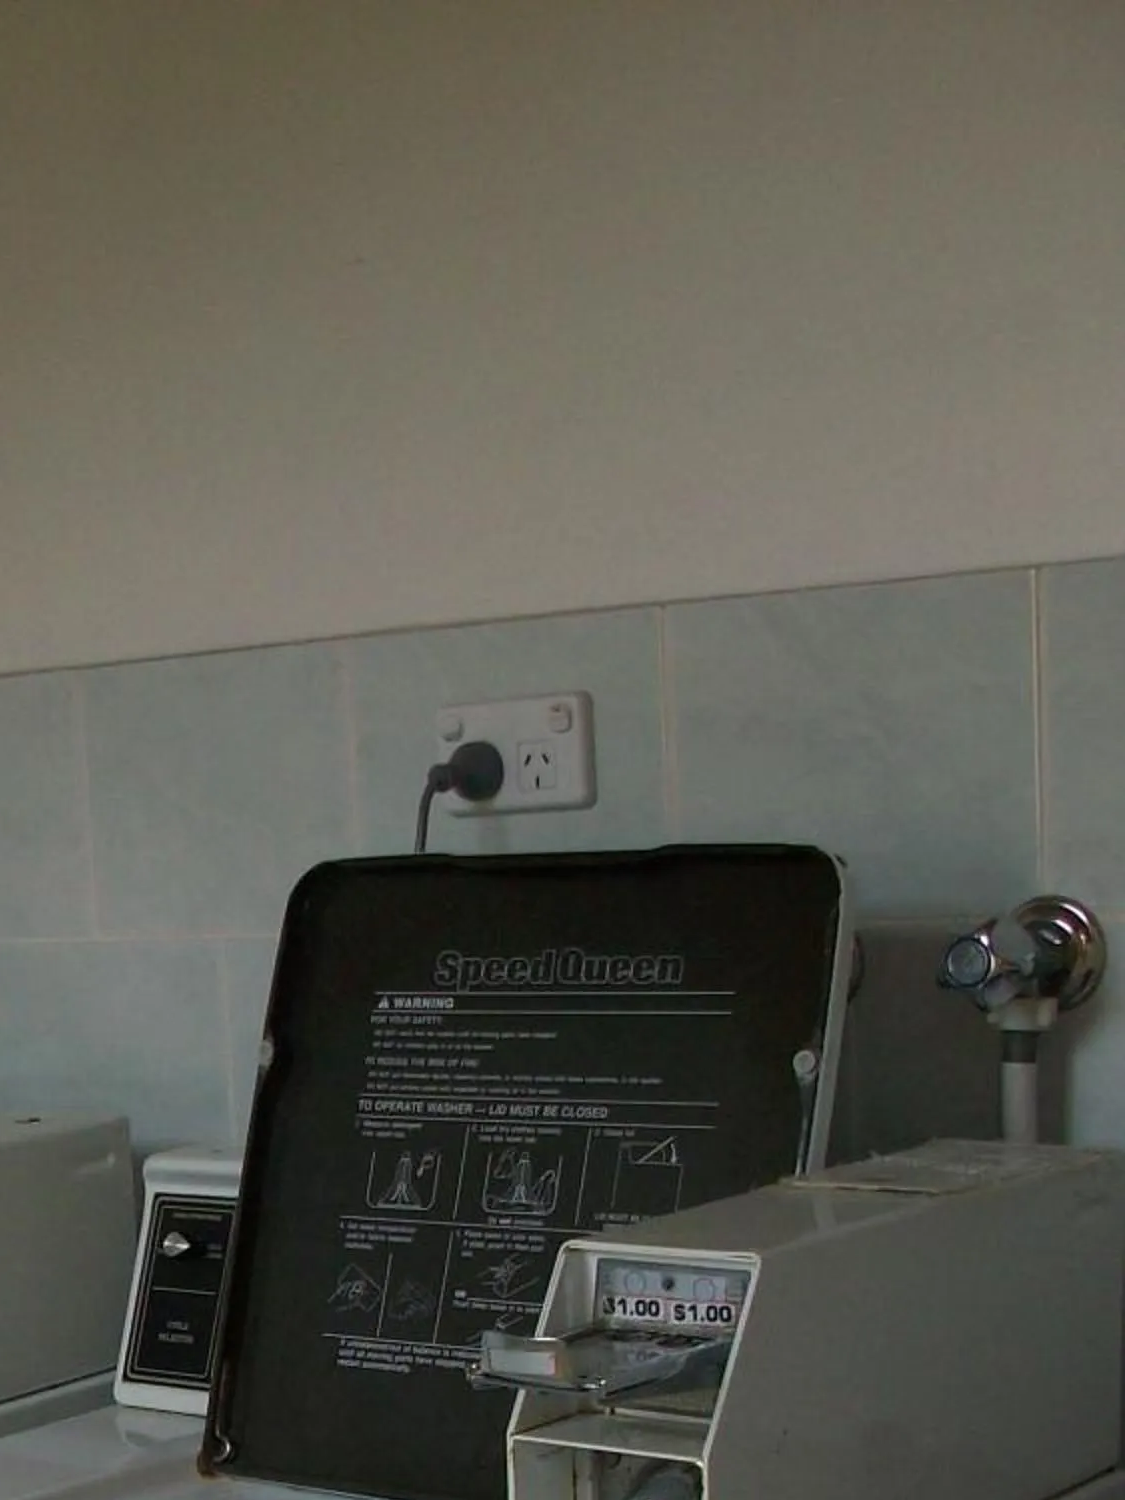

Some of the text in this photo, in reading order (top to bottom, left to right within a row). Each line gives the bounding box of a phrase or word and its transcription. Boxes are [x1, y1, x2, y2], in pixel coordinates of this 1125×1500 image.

[433, 948, 684, 991] Speed Queen
[394, 997, 454, 1009] WARNING
[359, 1099, 608, 1119] TO OPERATE WASHER LID MUST BE CLOSED
[674, 1304, 732, 1322] $1.00
